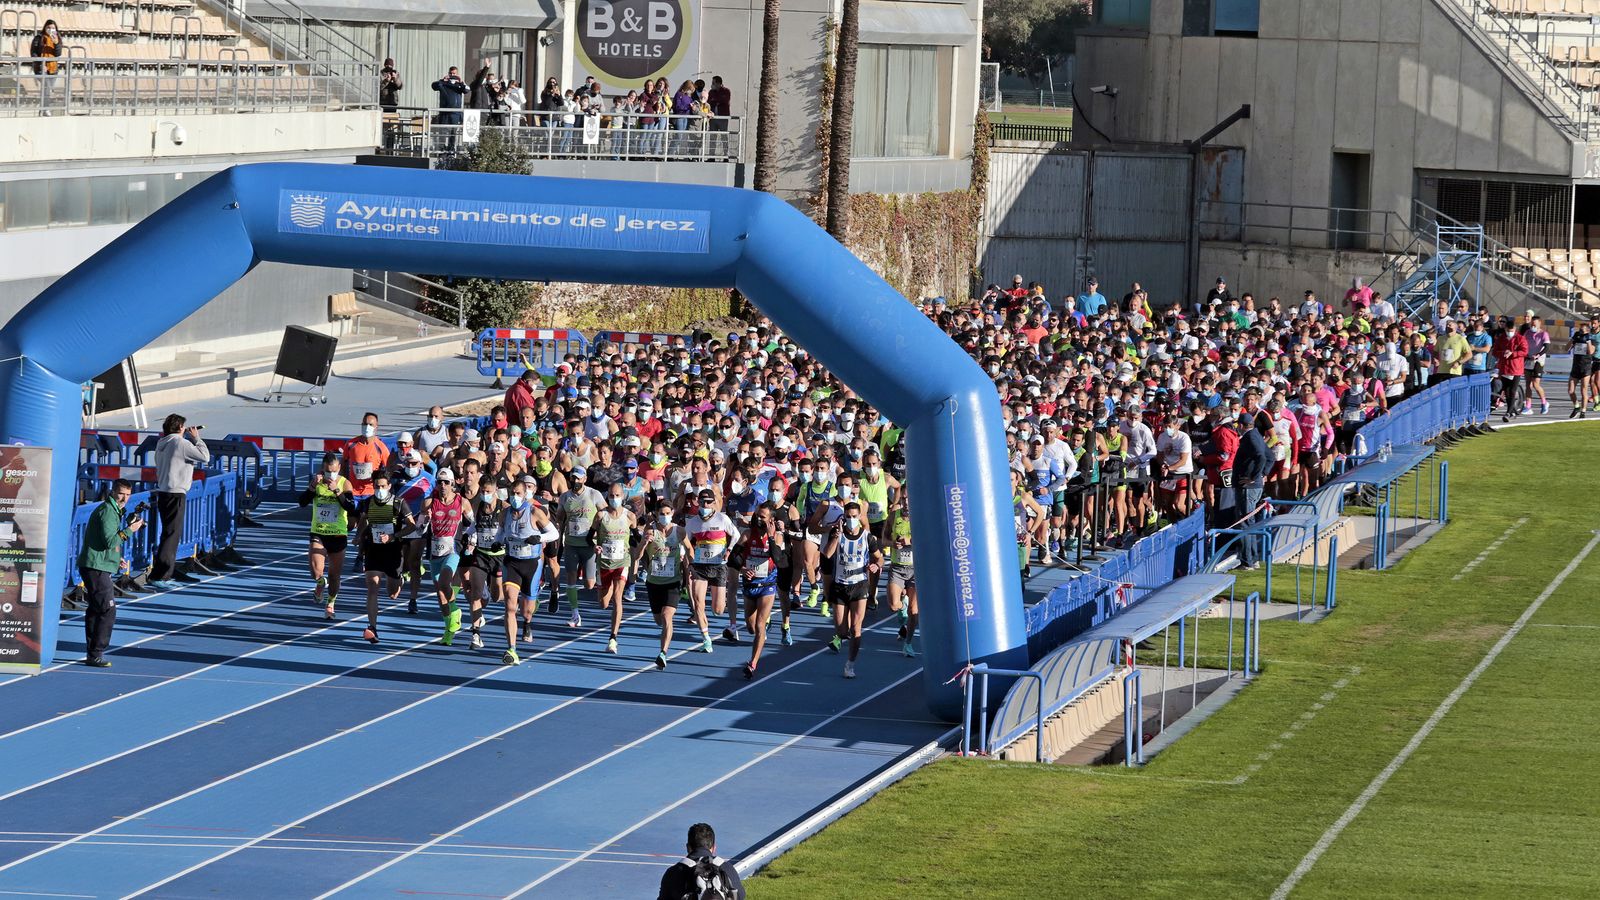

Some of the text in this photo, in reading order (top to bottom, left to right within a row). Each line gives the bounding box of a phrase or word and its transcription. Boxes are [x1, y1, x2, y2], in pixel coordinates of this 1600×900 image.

[598, 43, 663, 57] HOTELS
[336, 200, 696, 232] Ayuntamiento de Jerez
[336, 218, 440, 235] Deportes
[4, 477, 21, 485] chip
[5, 469, 38, 478] gescon
[948, 487, 975, 617] deportes@aytojerez.es
